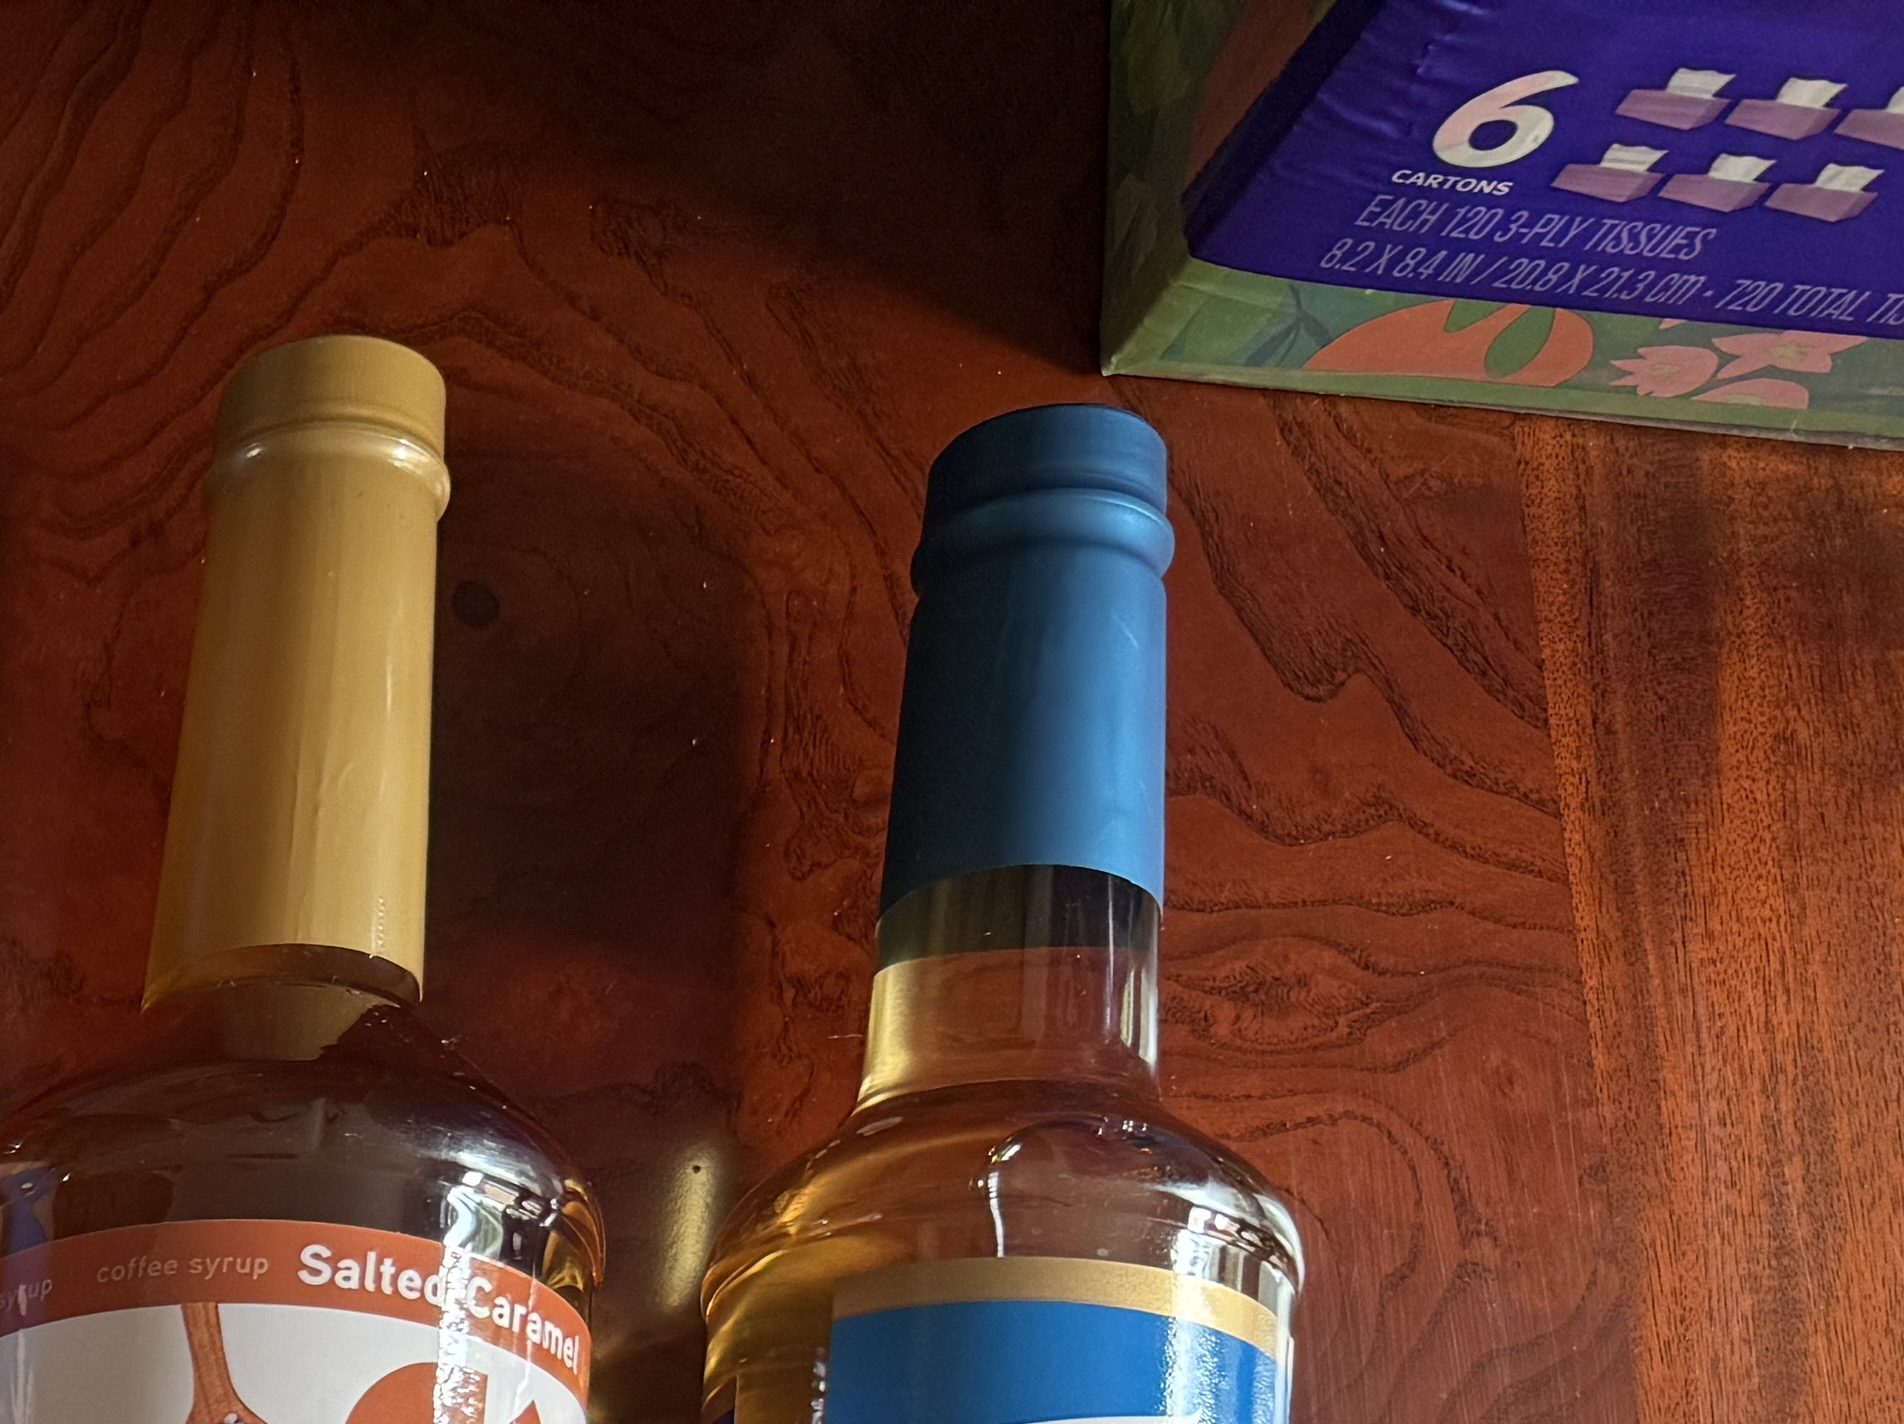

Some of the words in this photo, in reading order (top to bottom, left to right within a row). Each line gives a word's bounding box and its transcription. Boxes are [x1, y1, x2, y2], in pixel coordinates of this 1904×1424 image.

[1433, 70, 1580, 168] 6
[1392, 170, 1513, 196] CARTONS
[1355, 195, 1445, 232] EACH
[1441, 206, 1500, 240] 120
[1496, 210, 1595, 248] 3-PLY
[1593, 218, 1717, 261] TISSUES
[1320, 238, 1374, 272] 8.2
[1396, 247, 1447, 279] 8.4
[1439, 252, 1484, 283] IN
[1492, 257, 1570, 292] 20.8
[1582, 267, 1654, 301] 21.3
[1716, 279, 1784, 312] 720
[1774, 284, 1871, 322] TOTAL
[96, 1255, 178, 1284] coffee
[187, 1253, 269, 1280] syrup
[298, 1245, 448, 1305] Salted
[468, 1275, 580, 1377] Caramel
